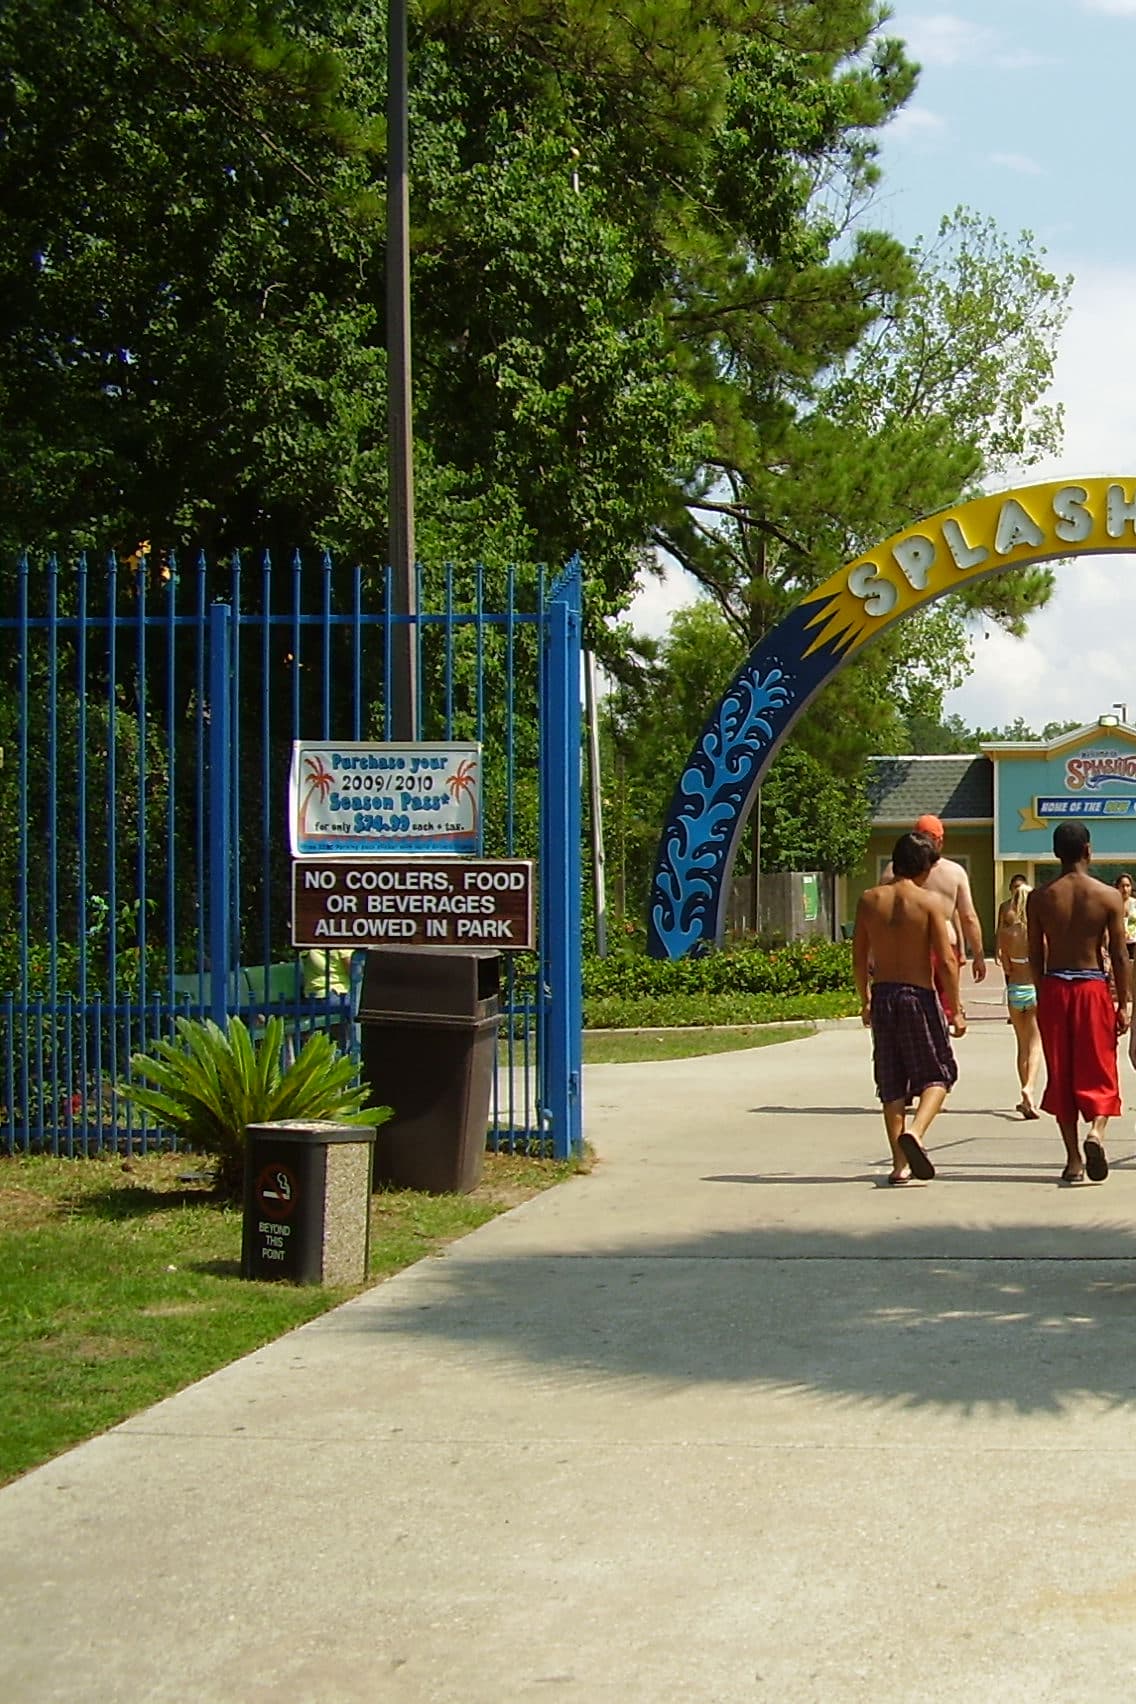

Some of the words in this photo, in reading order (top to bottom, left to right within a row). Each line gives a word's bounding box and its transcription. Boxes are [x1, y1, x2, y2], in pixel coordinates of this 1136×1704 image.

[331, 753, 405, 770] Purchase
[410, 756, 448, 774] your
[342, 774, 433, 792] 2009/2010
[329, 792, 394, 811] Season
[1040, 801, 1068, 813] HOME
[1070, 801, 1082, 812] OF
[1084, 801, 1101, 812] THE
[315, 822, 329, 831] for
[332, 822, 351, 833] only
[412, 822, 434, 831] each
[305, 871, 336, 889] NO
[346, 871, 454, 893] COOLERS,
[464, 872, 525, 890] FOOD
[326, 895, 357, 913] OR
[367, 895, 496, 914] BEVERAGES
[314, 919, 417, 937] ALLOWED
[426, 919, 448, 937] IN
[457, 919, 514, 938] PARK
[258, 1221, 291, 1236] BEYOND
[265, 1235, 284, 1248] THIS
[262, 1247, 286, 1261] POINT
